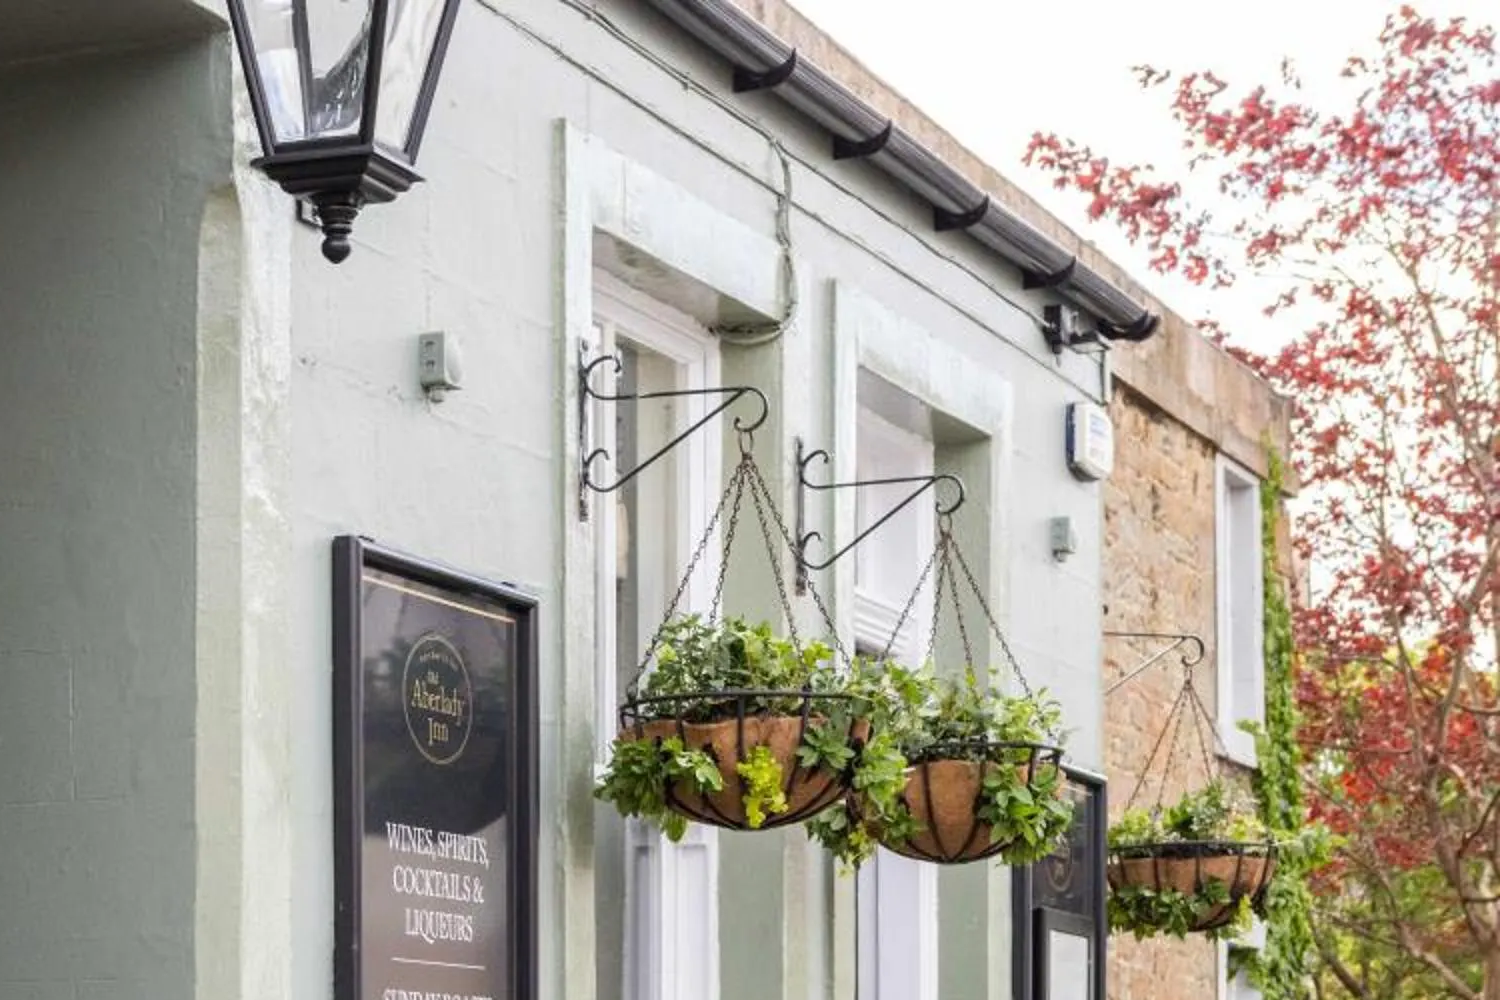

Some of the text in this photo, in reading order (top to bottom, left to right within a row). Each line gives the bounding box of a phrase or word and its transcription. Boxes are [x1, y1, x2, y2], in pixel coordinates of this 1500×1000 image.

[385, 821, 490, 870] WINES, SPIRITS,
[392, 864, 485, 904] COCKTAILS &
[404, 907, 474, 944] LIQUEURS
